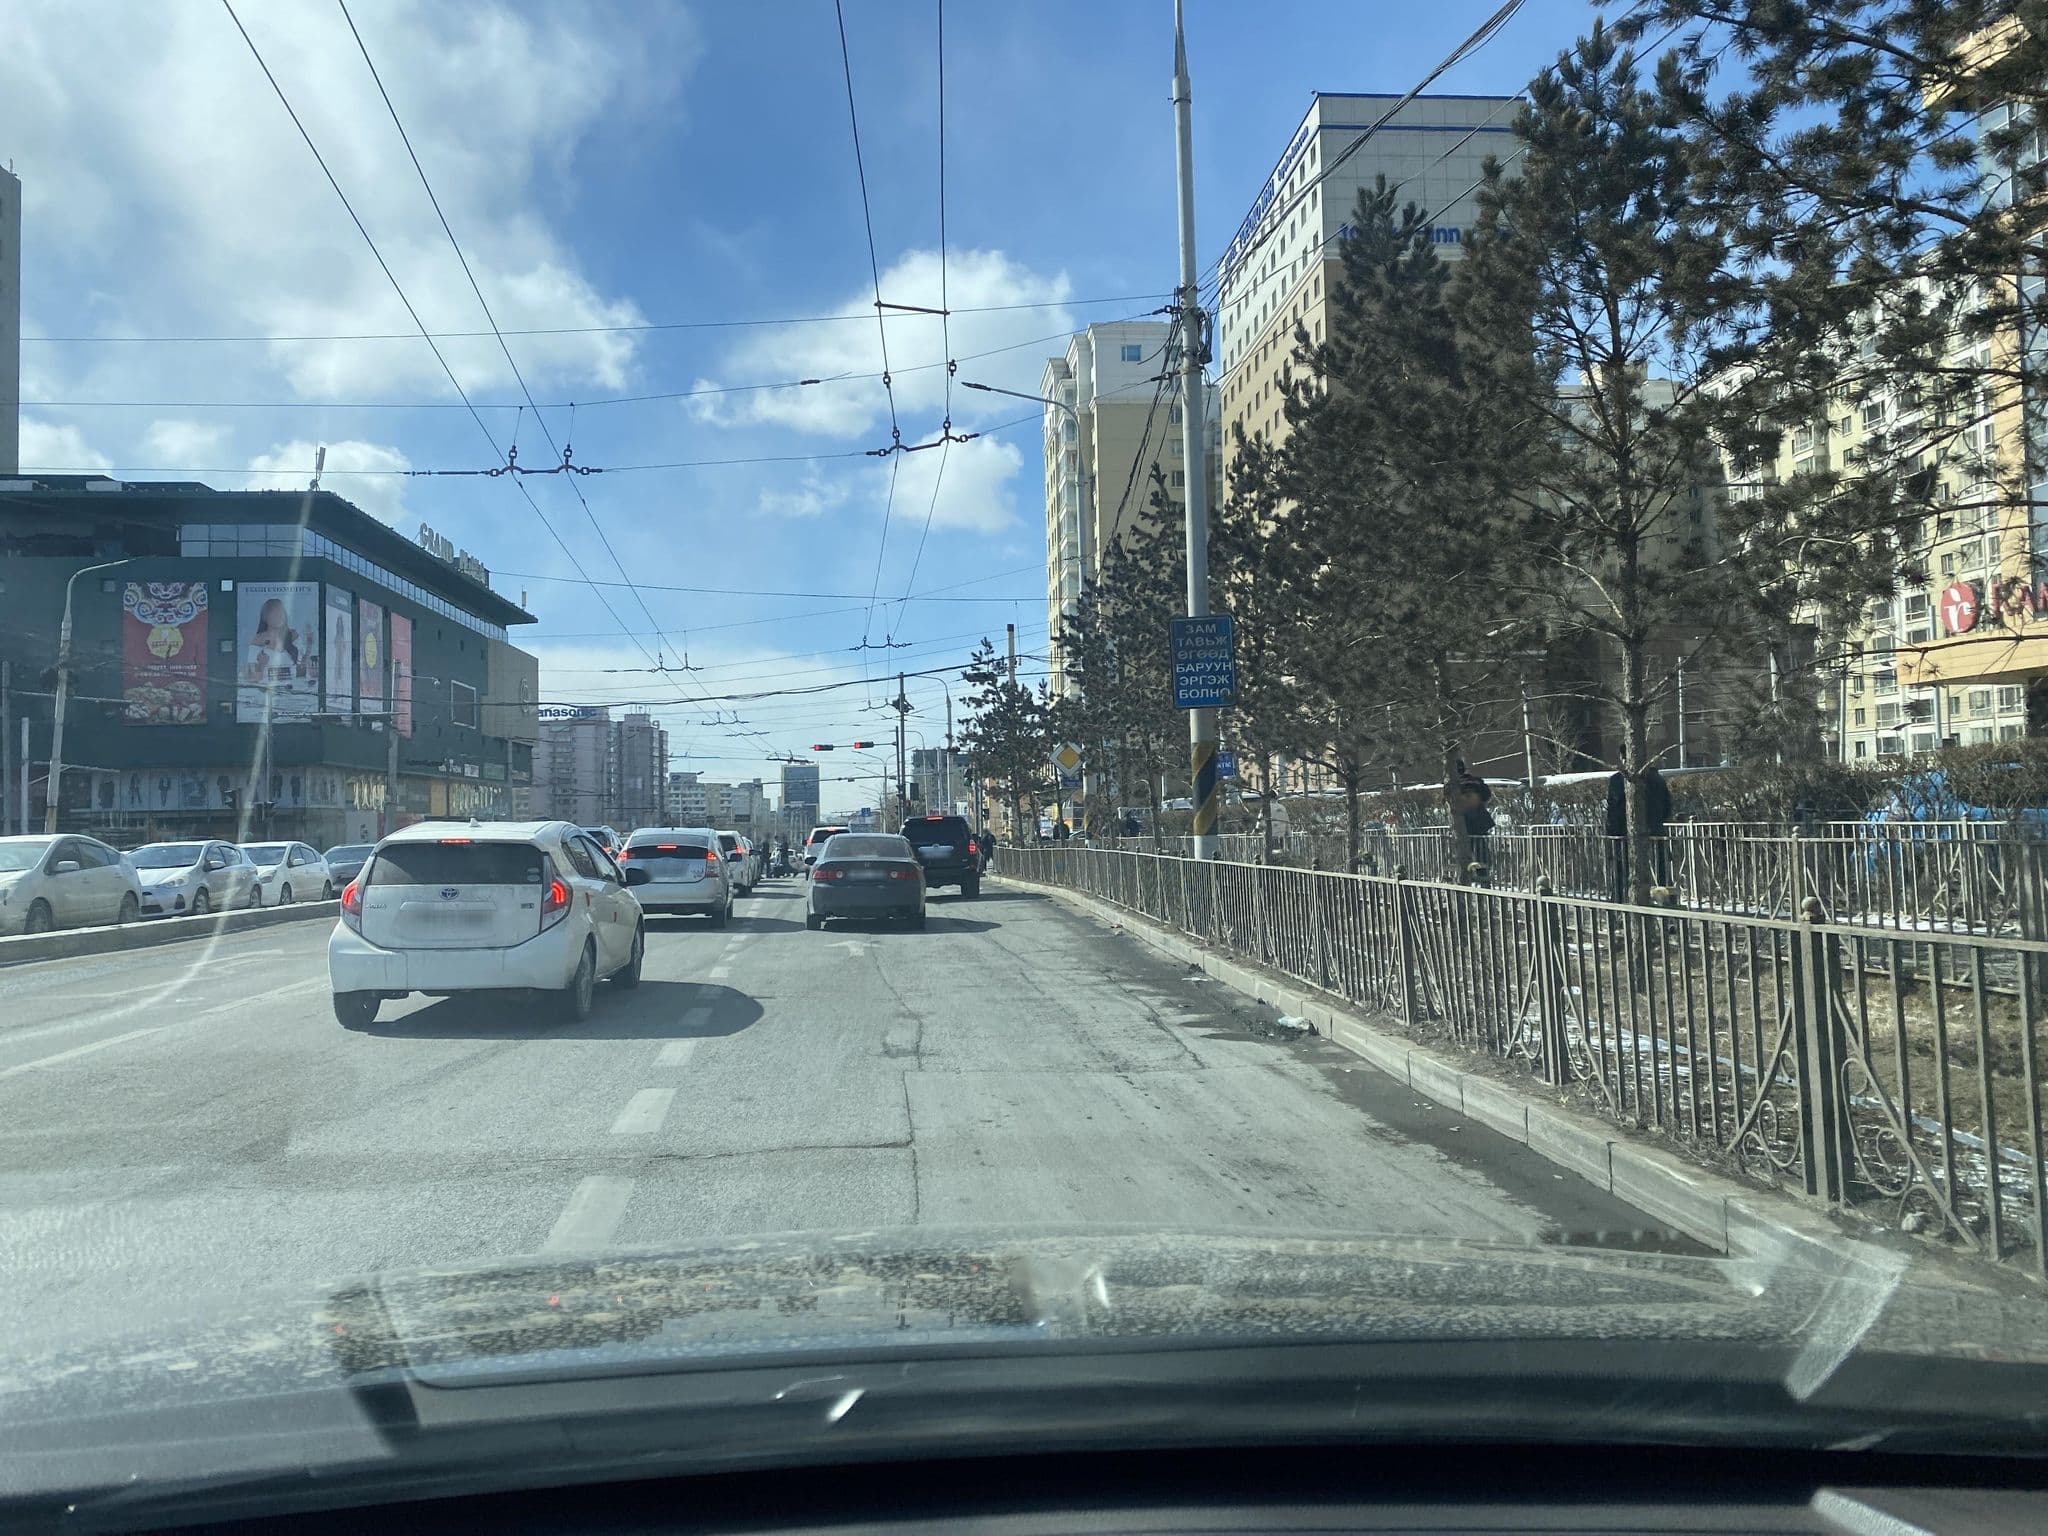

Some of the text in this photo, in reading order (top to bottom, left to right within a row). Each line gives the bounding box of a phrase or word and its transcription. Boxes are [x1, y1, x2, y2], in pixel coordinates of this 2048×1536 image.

[419, 522, 455, 564] GRAND
[1185, 623, 1217, 634] ЗАМ
[1176, 635, 1228, 647] ТАВЬЖ
[1177, 648, 1229, 660] ӨГӨӨД
[1176, 661, 1232, 673] БАРУУН
[1179, 675, 1230, 686] ЭРГЭЖ
[1179, 687, 1231, 699] БОЛНО
[538, 708, 597, 718] anasonic
